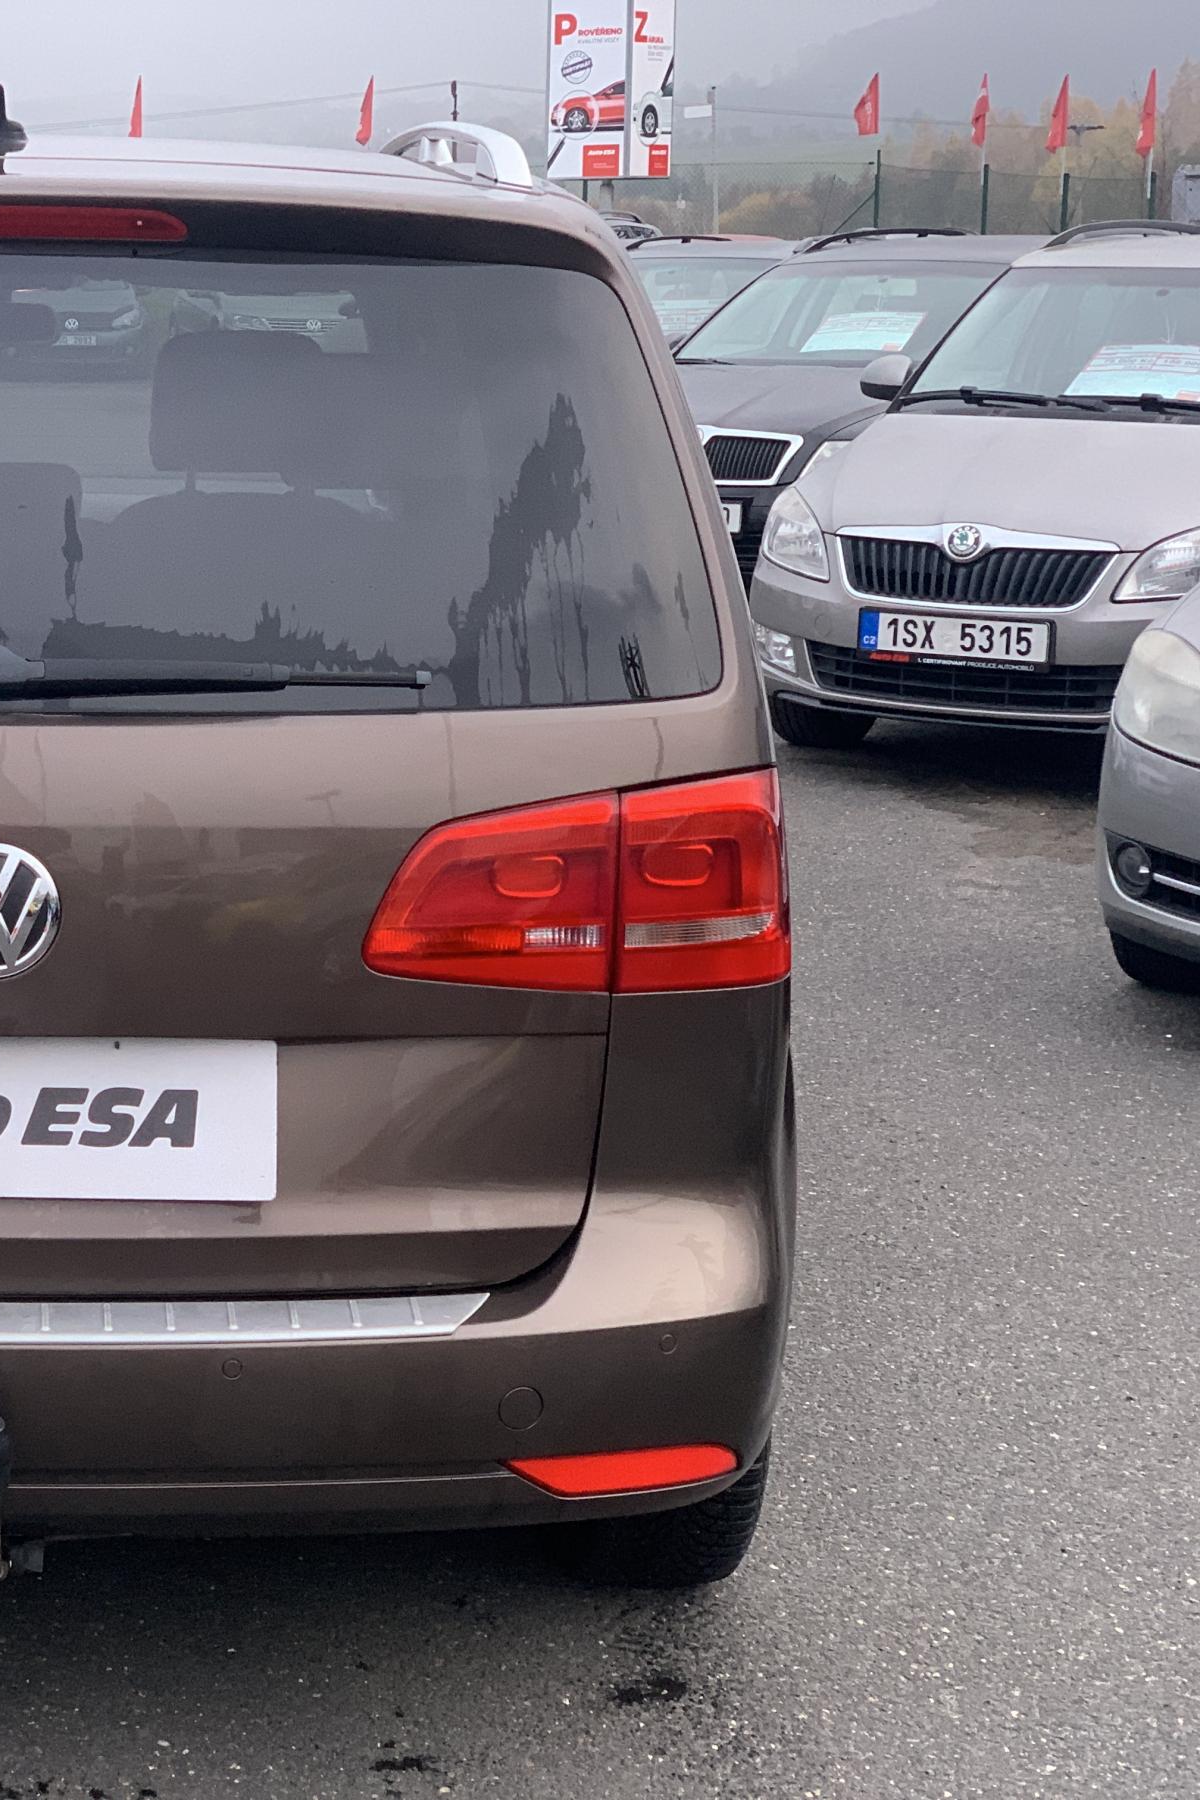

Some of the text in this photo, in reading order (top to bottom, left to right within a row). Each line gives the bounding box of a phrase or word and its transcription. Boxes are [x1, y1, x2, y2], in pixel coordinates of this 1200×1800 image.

[863, 635, 876, 645] CZ
[887, 618, 1033, 656] 1SX 5315
[21, 1086, 199, 1148] ESA
